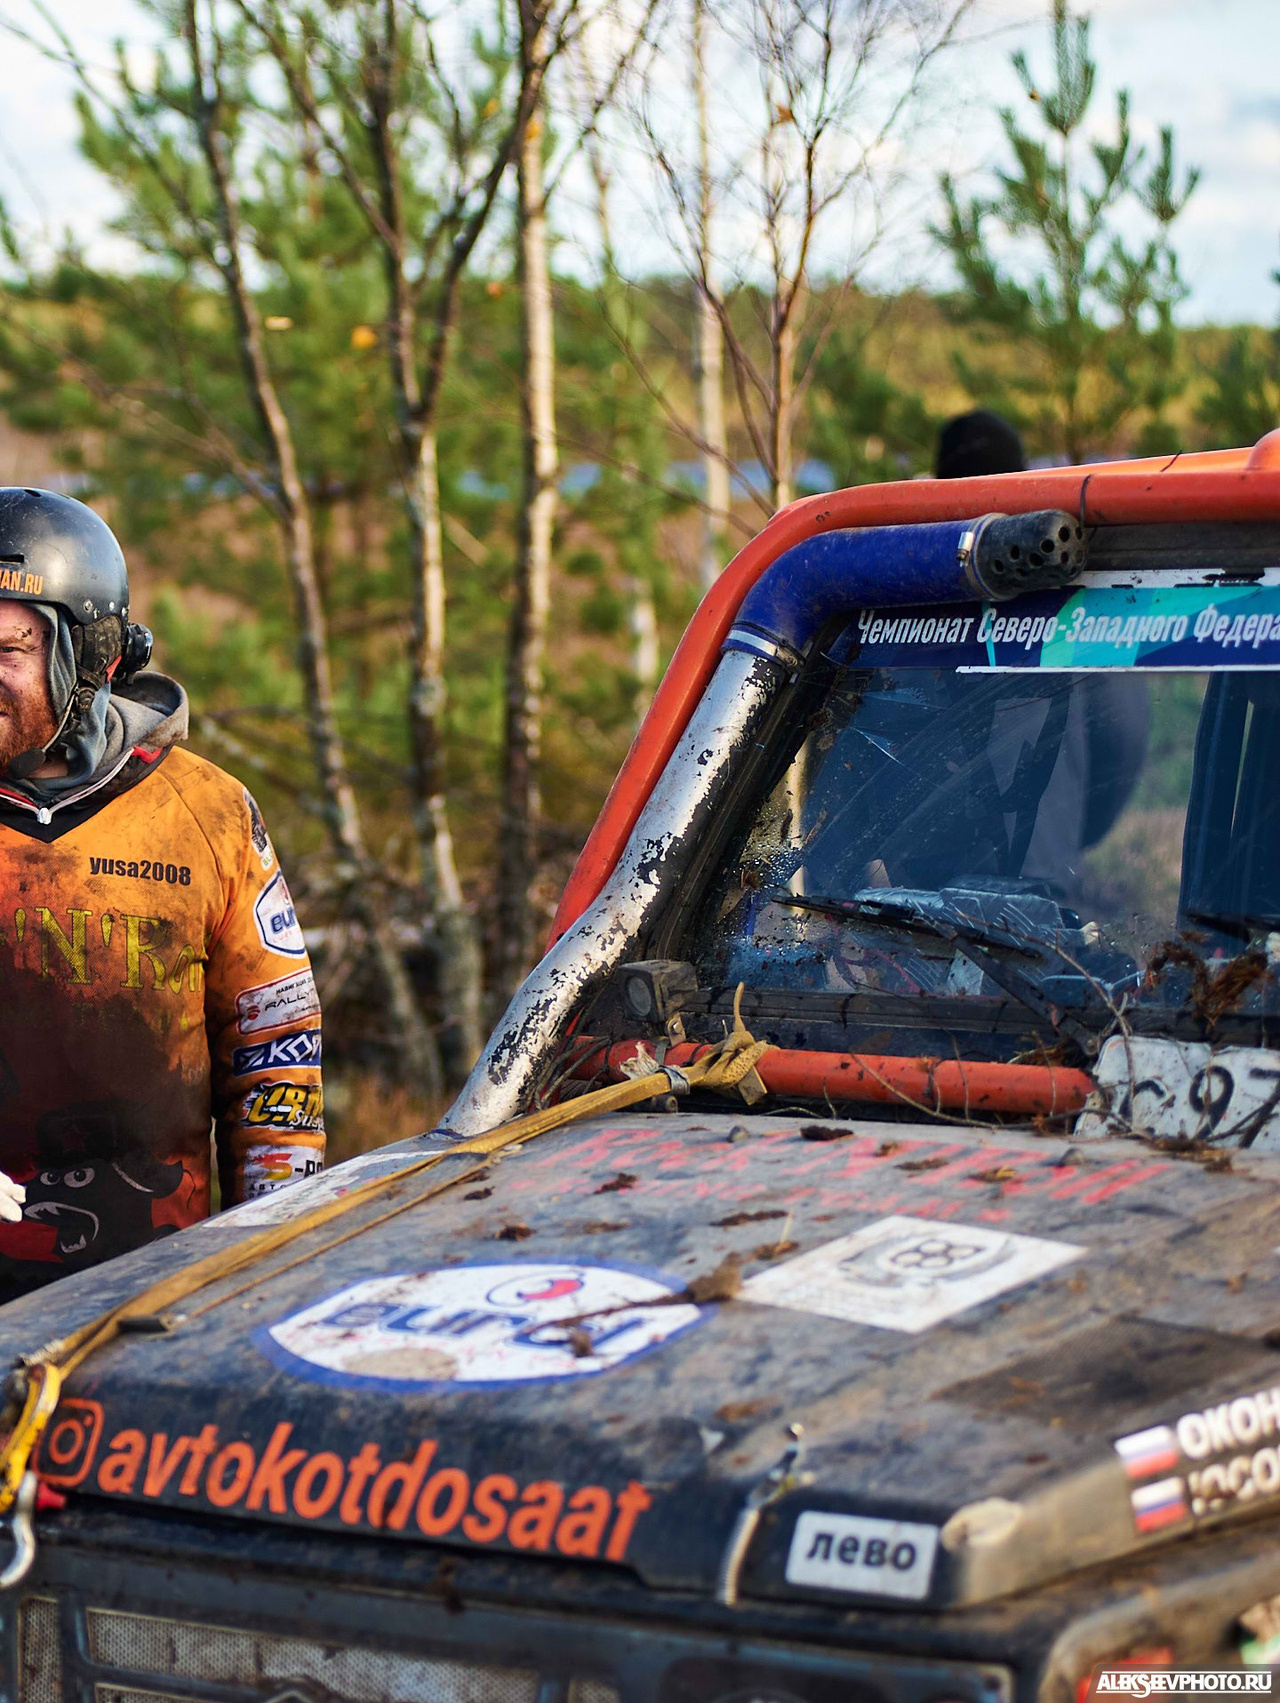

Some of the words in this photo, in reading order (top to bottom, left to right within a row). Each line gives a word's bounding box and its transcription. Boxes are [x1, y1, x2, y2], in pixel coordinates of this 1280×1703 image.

[857, 609, 975, 645] Чемпионат
[976, 606, 1184, 651] Северо-Западного
[1193, 603, 1280, 649] Федера
[89, 856, 192, 886] yusa2008
[96, 1420, 654, 1562] avtokotdosaat
[807, 1532, 918, 1572] лево
